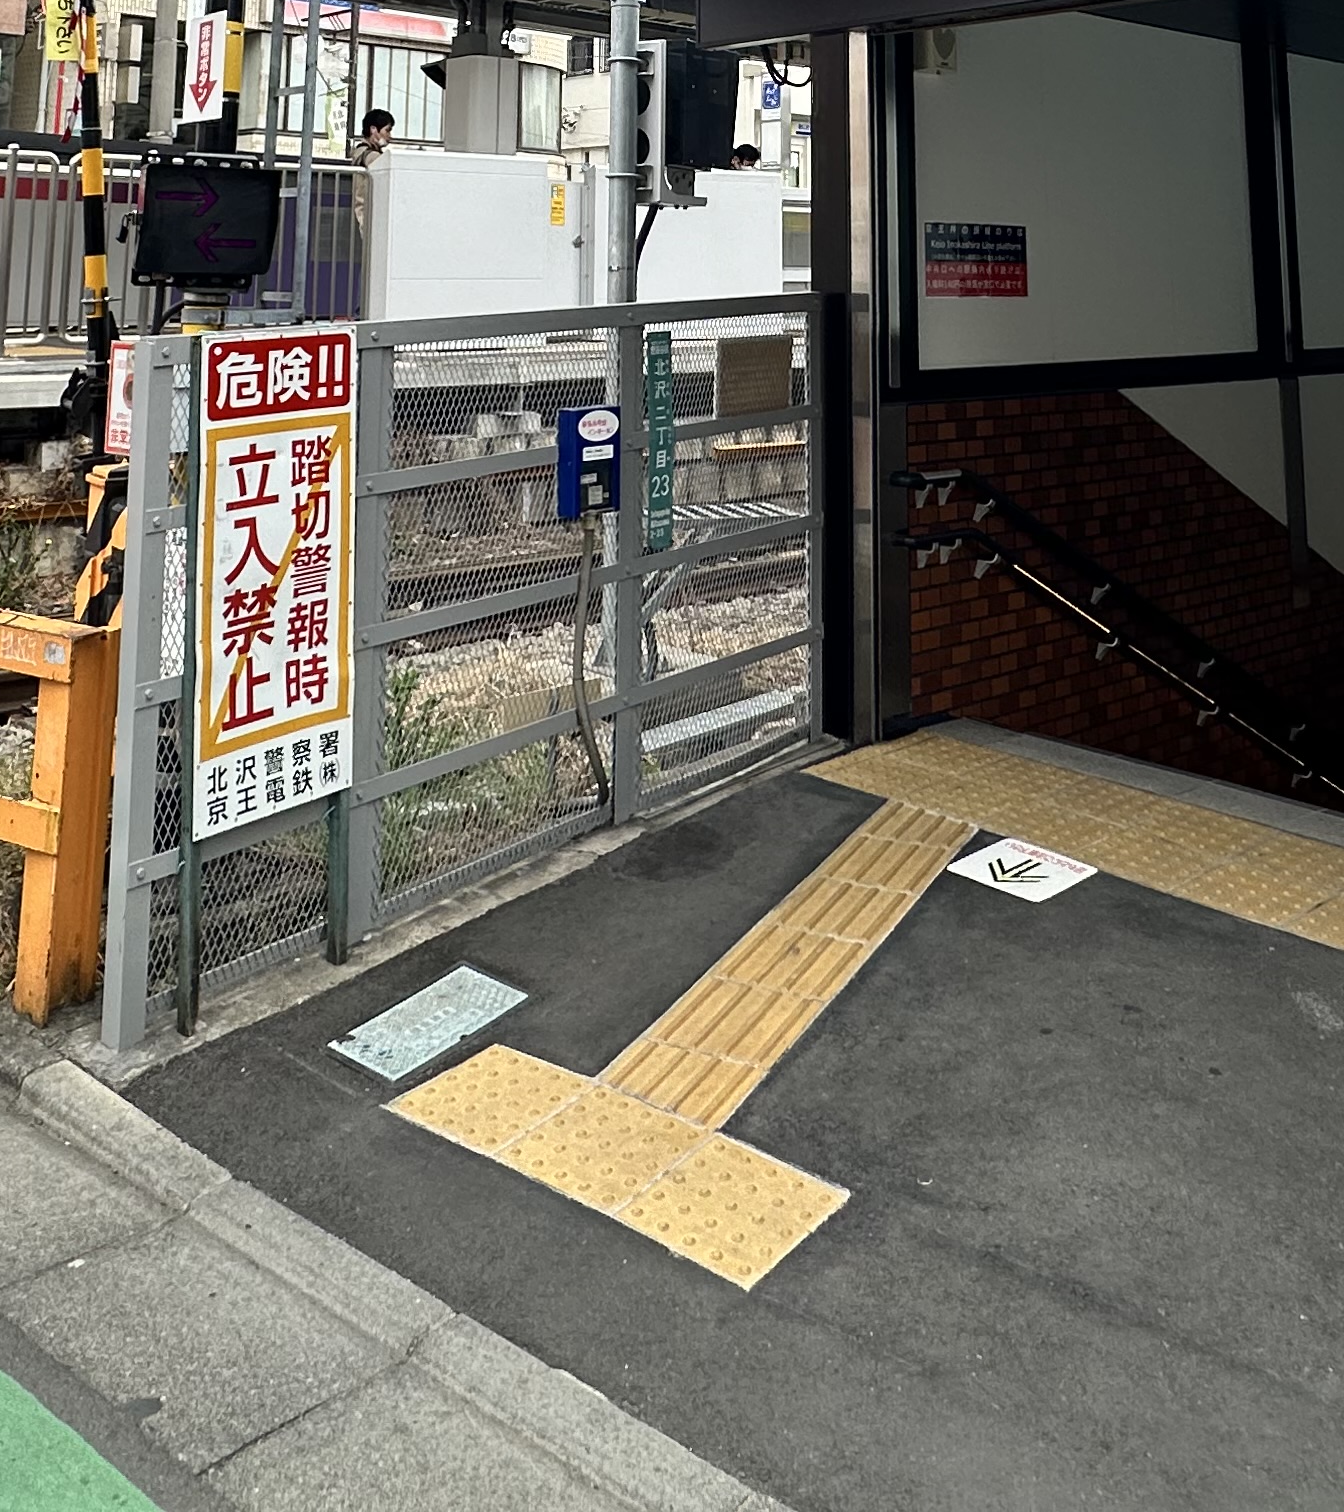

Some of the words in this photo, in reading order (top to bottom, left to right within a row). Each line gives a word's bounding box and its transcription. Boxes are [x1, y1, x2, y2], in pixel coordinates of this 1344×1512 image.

[197, 24, 211, 103] 非常ボタン
[215, 343, 345, 411] 危険!!
[654, 358, 667, 469] 北沢二丁目
[651, 474, 670, 498] 23
[222, 443, 280, 732] 立入禁止
[285, 435, 333, 709] 踏切警報時
[207, 730, 339, 795] 北沢警察署
